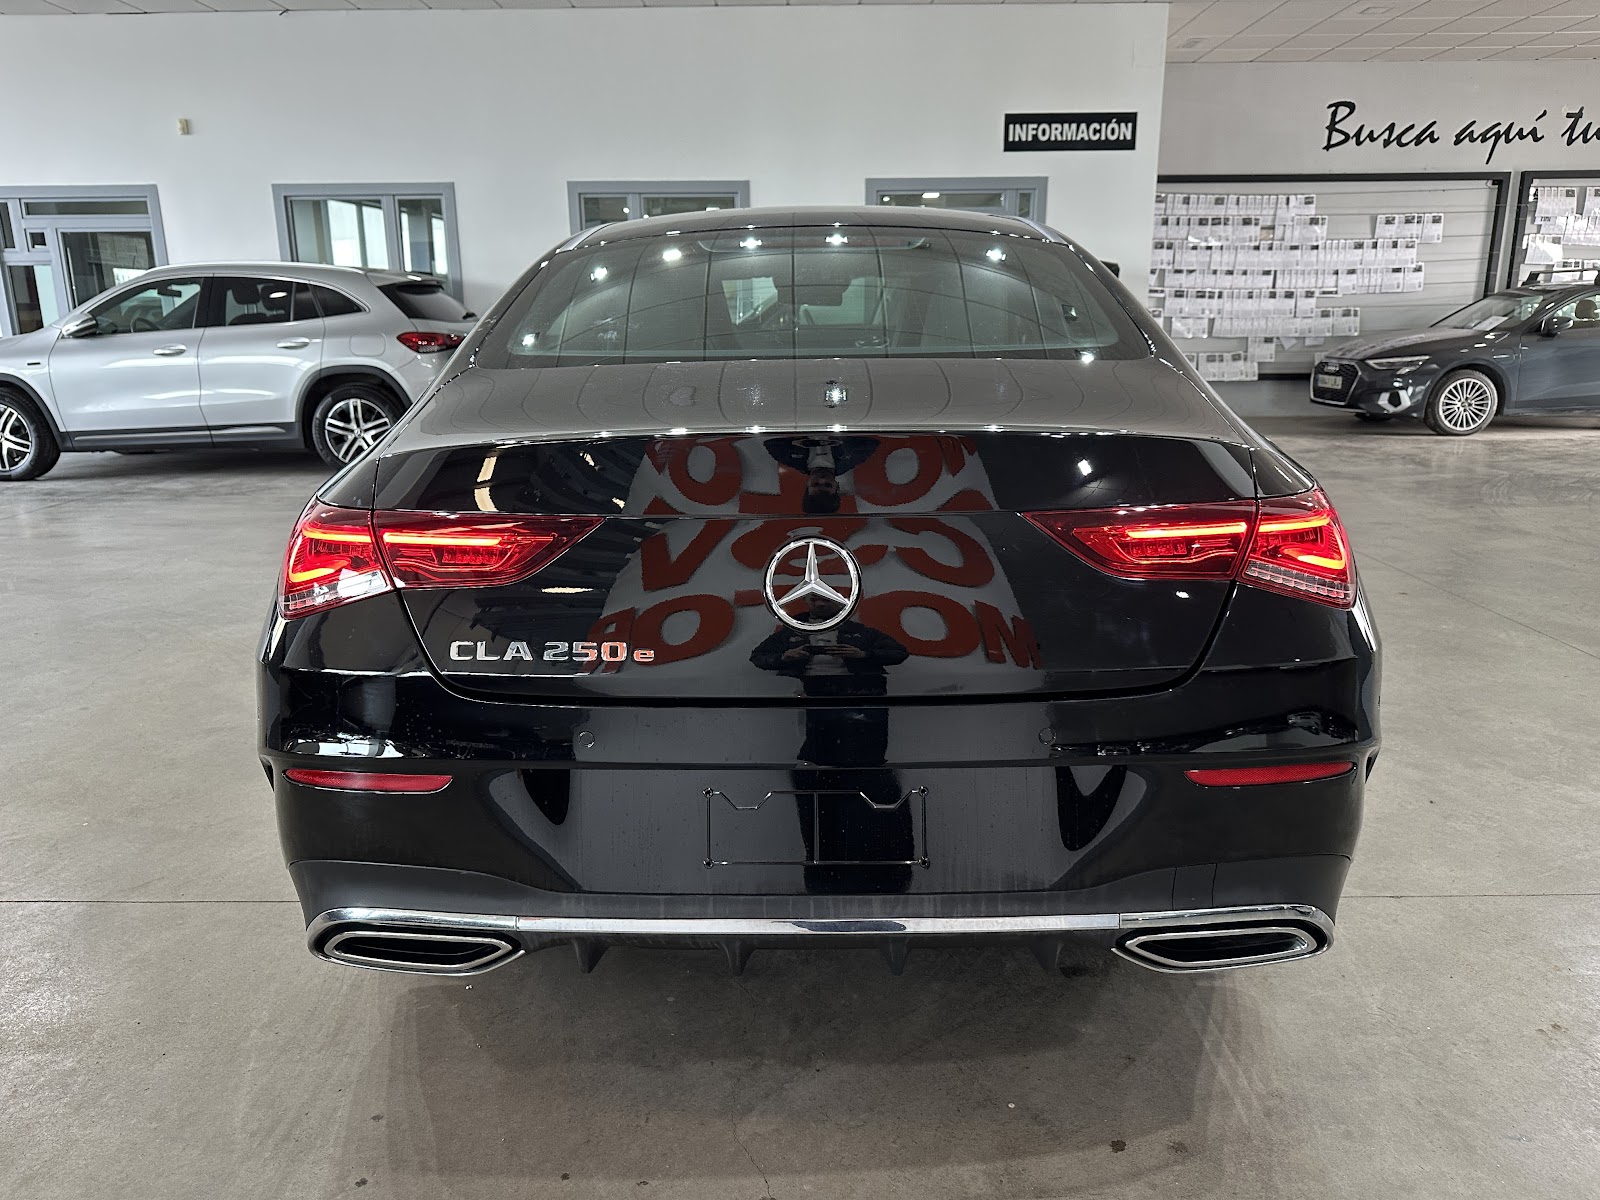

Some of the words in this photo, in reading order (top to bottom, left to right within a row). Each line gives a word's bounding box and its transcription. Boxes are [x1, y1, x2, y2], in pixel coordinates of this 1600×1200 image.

[1008, 118, 1133, 142] INFORMACIÓN
[1322, 100, 1440, 151] Busca
[1453, 109, 1548, 164] aquí
[449, 640, 534, 662] CLA
